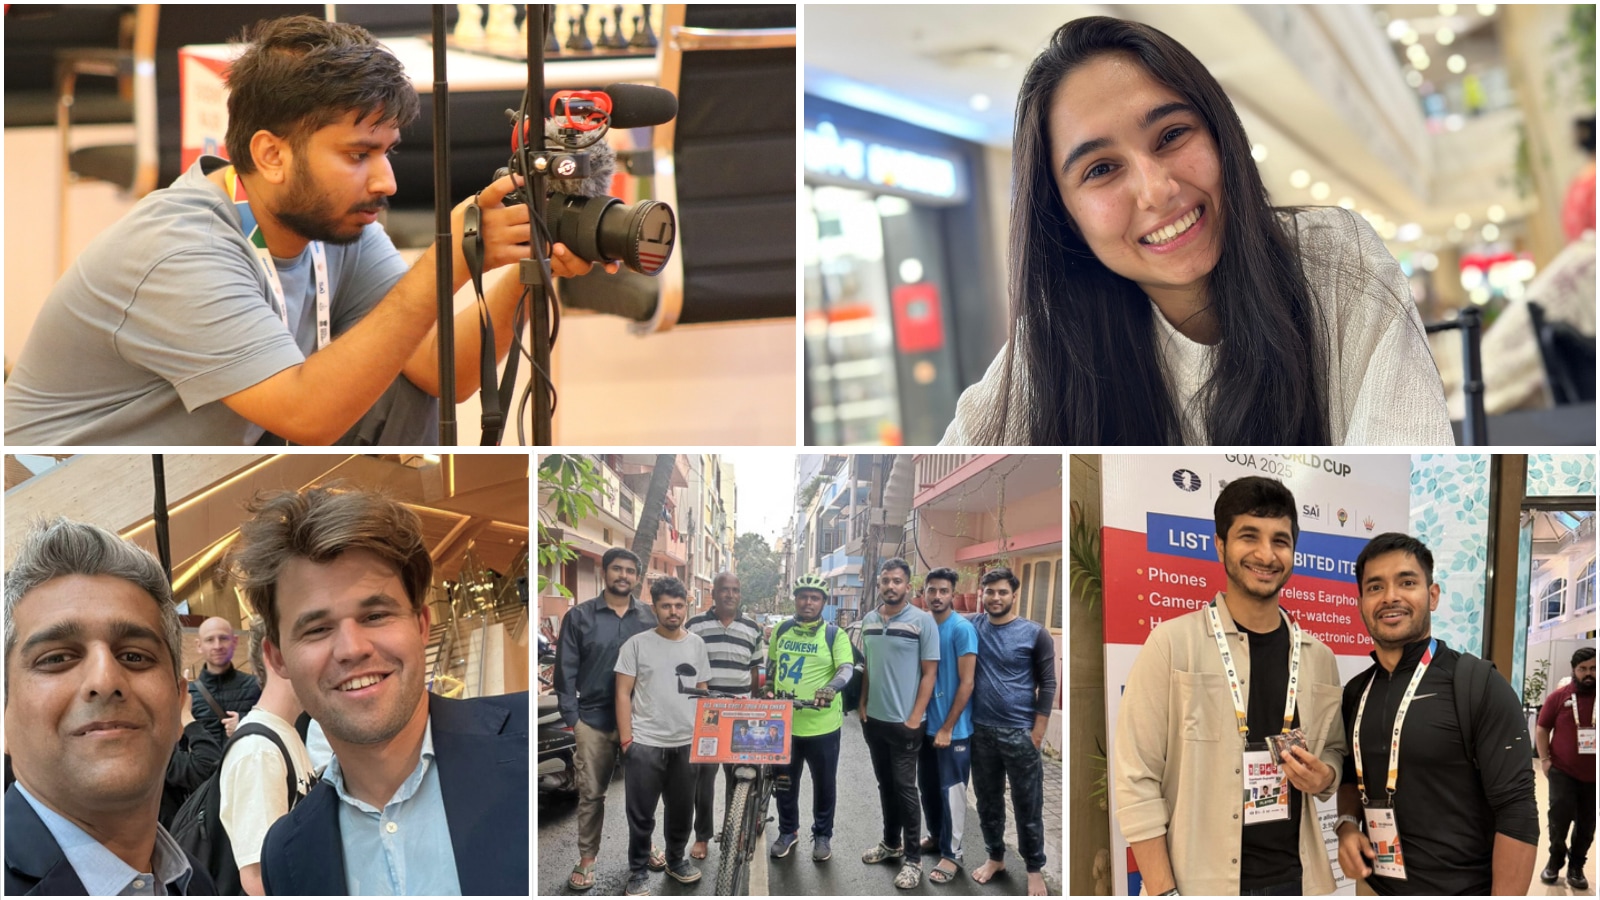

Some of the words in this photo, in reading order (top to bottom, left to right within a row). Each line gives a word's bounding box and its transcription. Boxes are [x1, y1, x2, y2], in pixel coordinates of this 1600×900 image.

[1260, 457, 1293, 478] 2025
[1323, 458, 1351, 477] CUP
[1169, 528, 1210, 551] LIST
[1293, 552, 1335, 572] BITED
[1337, 560, 1357, 576] ITE
[1148, 567, 1207, 588] Phones
[1149, 592, 1210, 610] Camera
[1280, 586, 1316, 601] reless
[1288, 608, 1352, 624] rt-watches
[784, 640, 818, 653] GUKESH
[1356, 633, 1375, 645] Dev
[778, 653, 806, 684] 64
